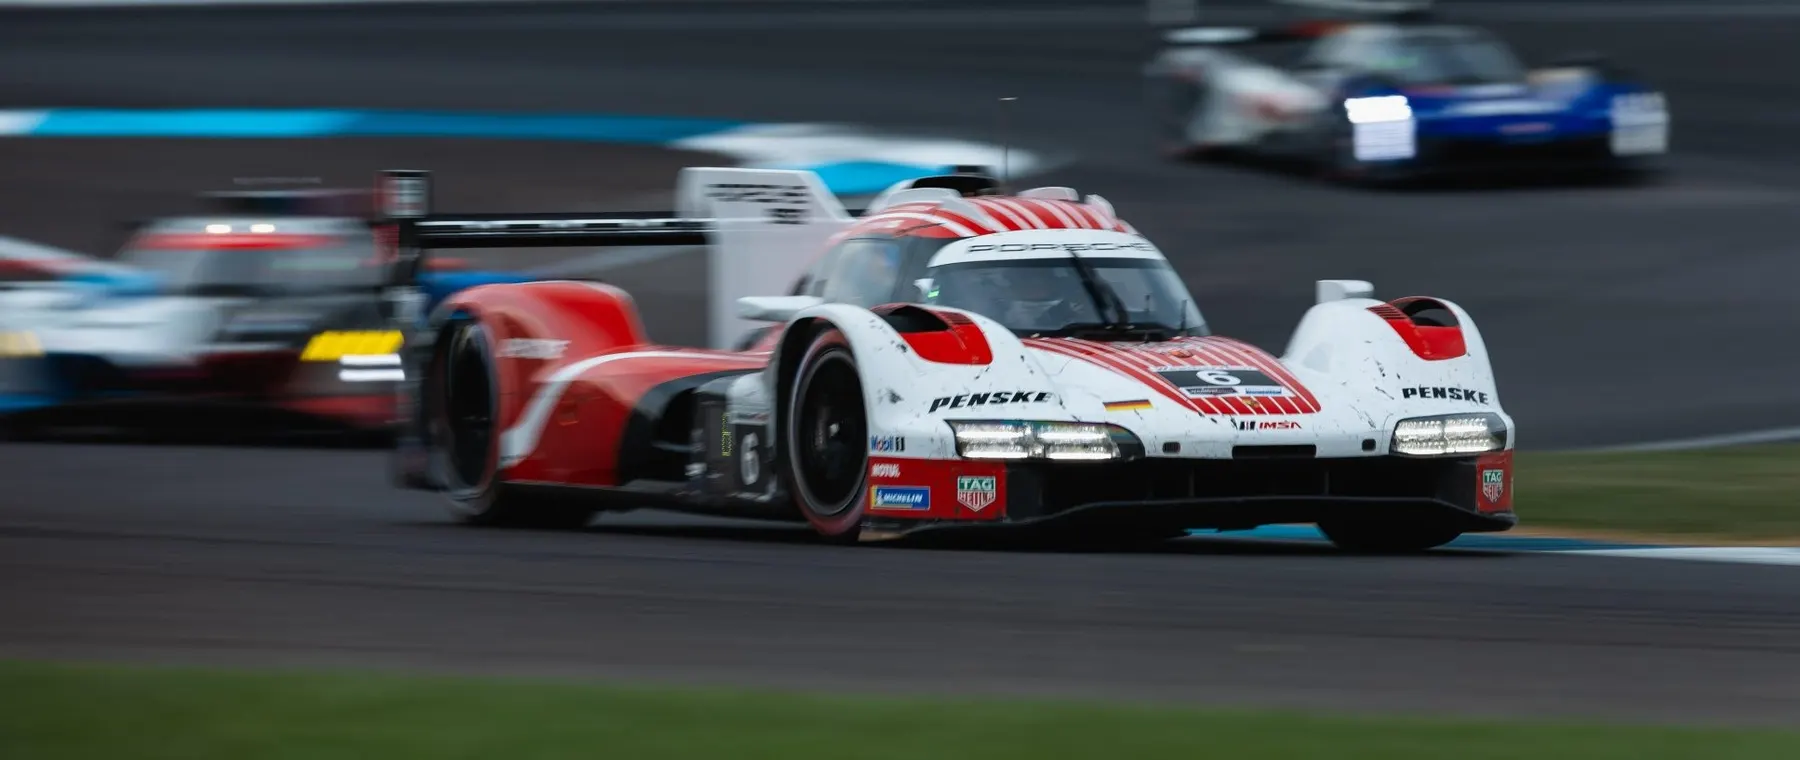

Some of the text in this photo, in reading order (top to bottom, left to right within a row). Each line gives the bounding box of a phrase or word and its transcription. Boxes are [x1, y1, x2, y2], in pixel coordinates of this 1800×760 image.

[1196, 370, 1242, 386] 6
[928, 391, 1053, 414] PENSKE
[1402, 386, 1489, 405] PENSKE
[871, 436, 894, 452] Mobil
[741, 432, 760, 486] 6
[960, 478, 993, 490] TAG
[1485, 471, 1502, 482] TAG
[883, 493, 923, 504] MICHELIN
